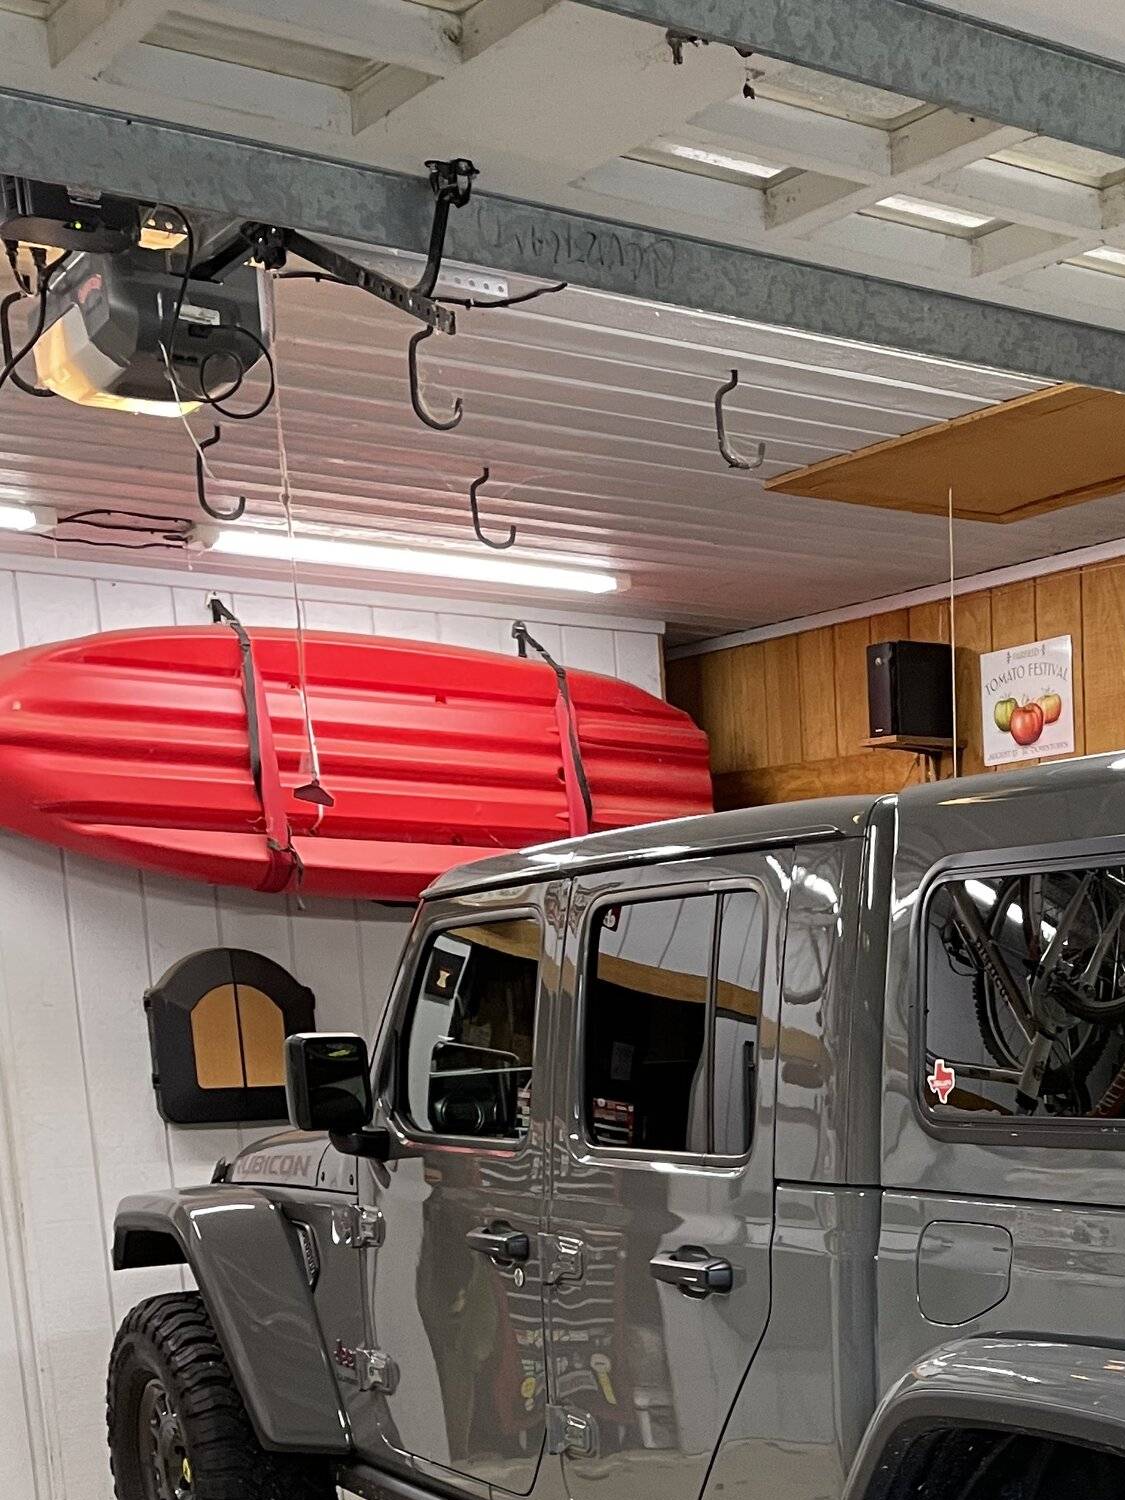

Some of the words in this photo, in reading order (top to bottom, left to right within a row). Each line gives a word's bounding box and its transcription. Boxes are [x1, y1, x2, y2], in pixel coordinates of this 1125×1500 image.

[984, 664, 1025, 696] TOMATO
[1028, 661, 1069, 682] FESTIVAL
[237, 1154, 312, 1178] RUBICON
